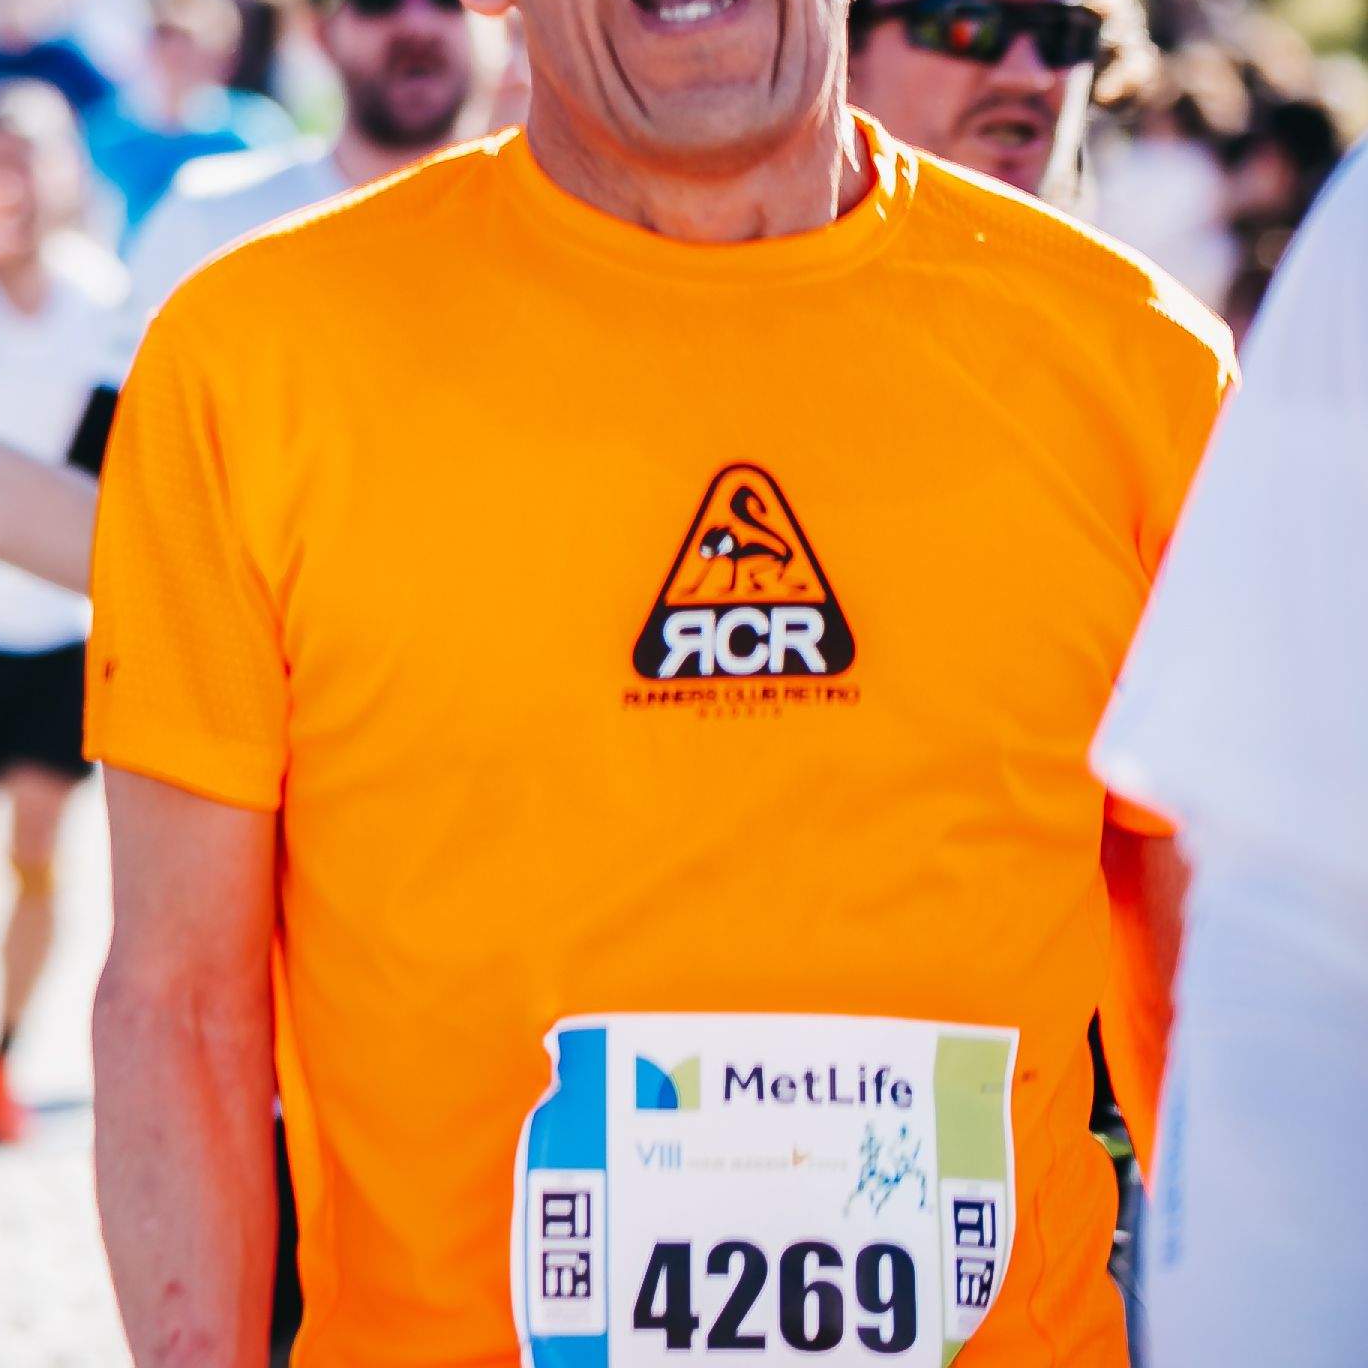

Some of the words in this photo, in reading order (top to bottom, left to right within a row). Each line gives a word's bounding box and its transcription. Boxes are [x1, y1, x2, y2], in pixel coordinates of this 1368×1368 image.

[723, 1063, 913, 1109] MetLife
[635, 1139, 682, 1170] VIII
[633, 1240, 919, 1354] 4269
